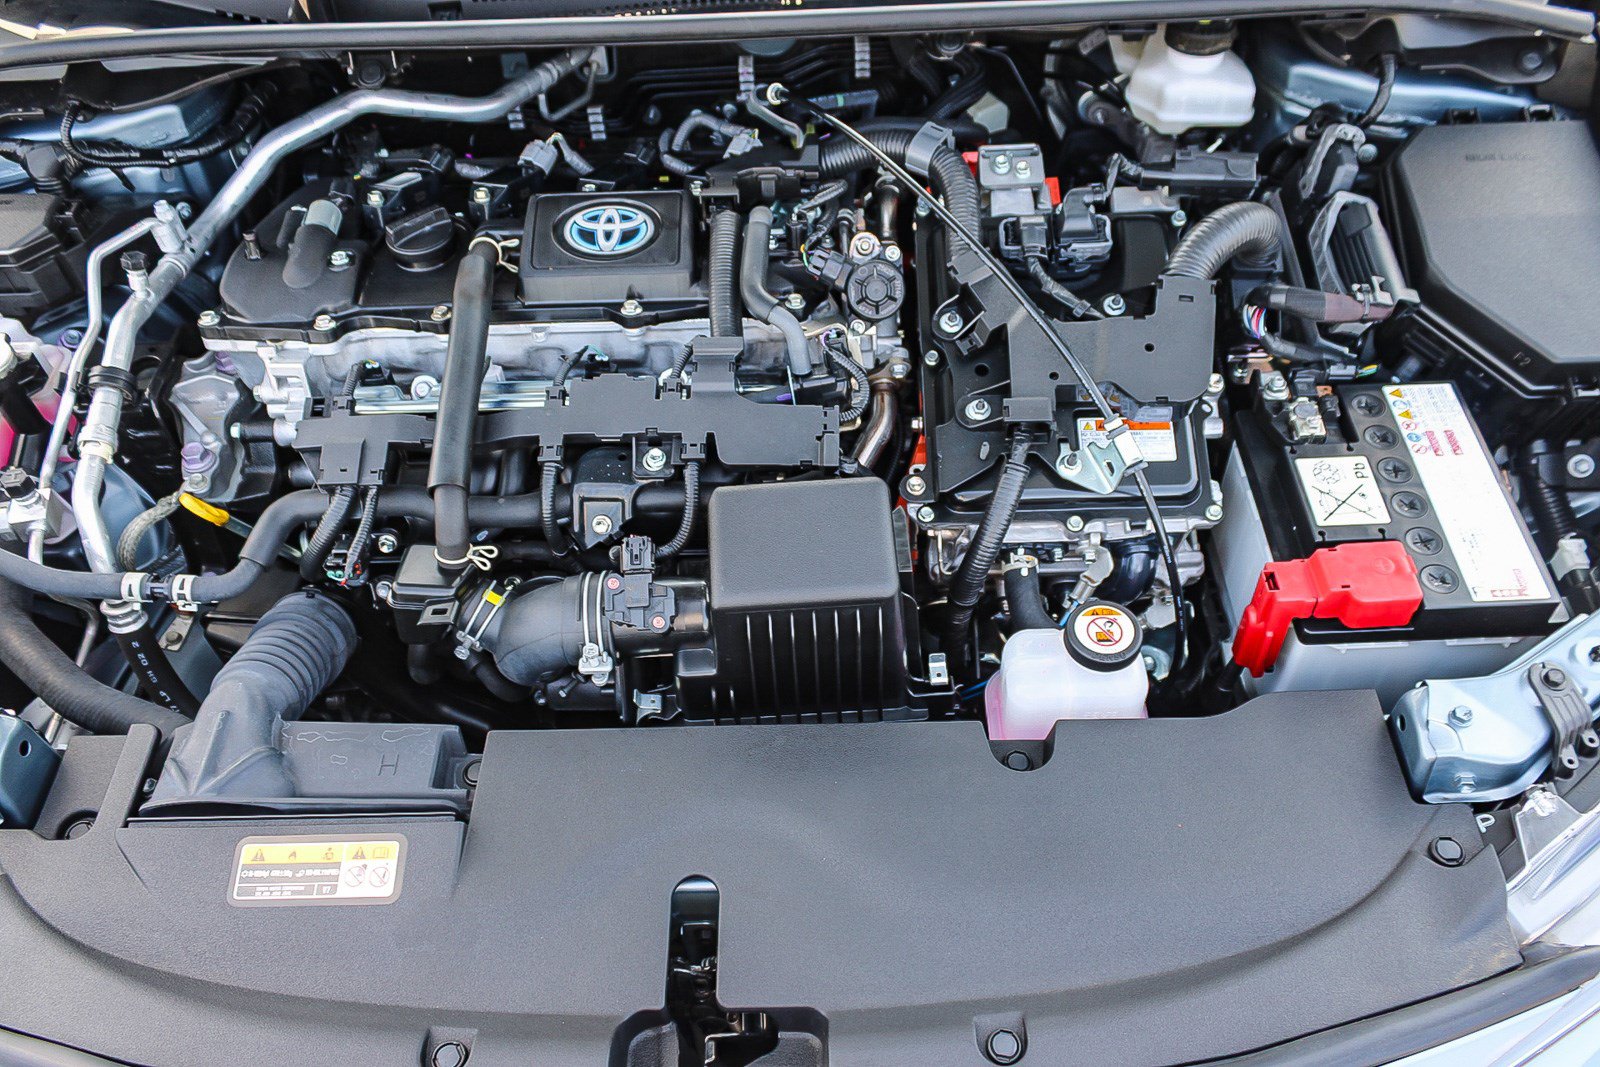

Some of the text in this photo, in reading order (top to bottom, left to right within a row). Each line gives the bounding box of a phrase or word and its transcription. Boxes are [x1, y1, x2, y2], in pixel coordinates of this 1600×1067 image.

[1353, 463, 1369, 479] Pb
[131, 641, 140, 649] 2
[138, 653, 149, 666] 02
[378, 753, 400, 777] H
[1475, 813, 1496, 834] P
